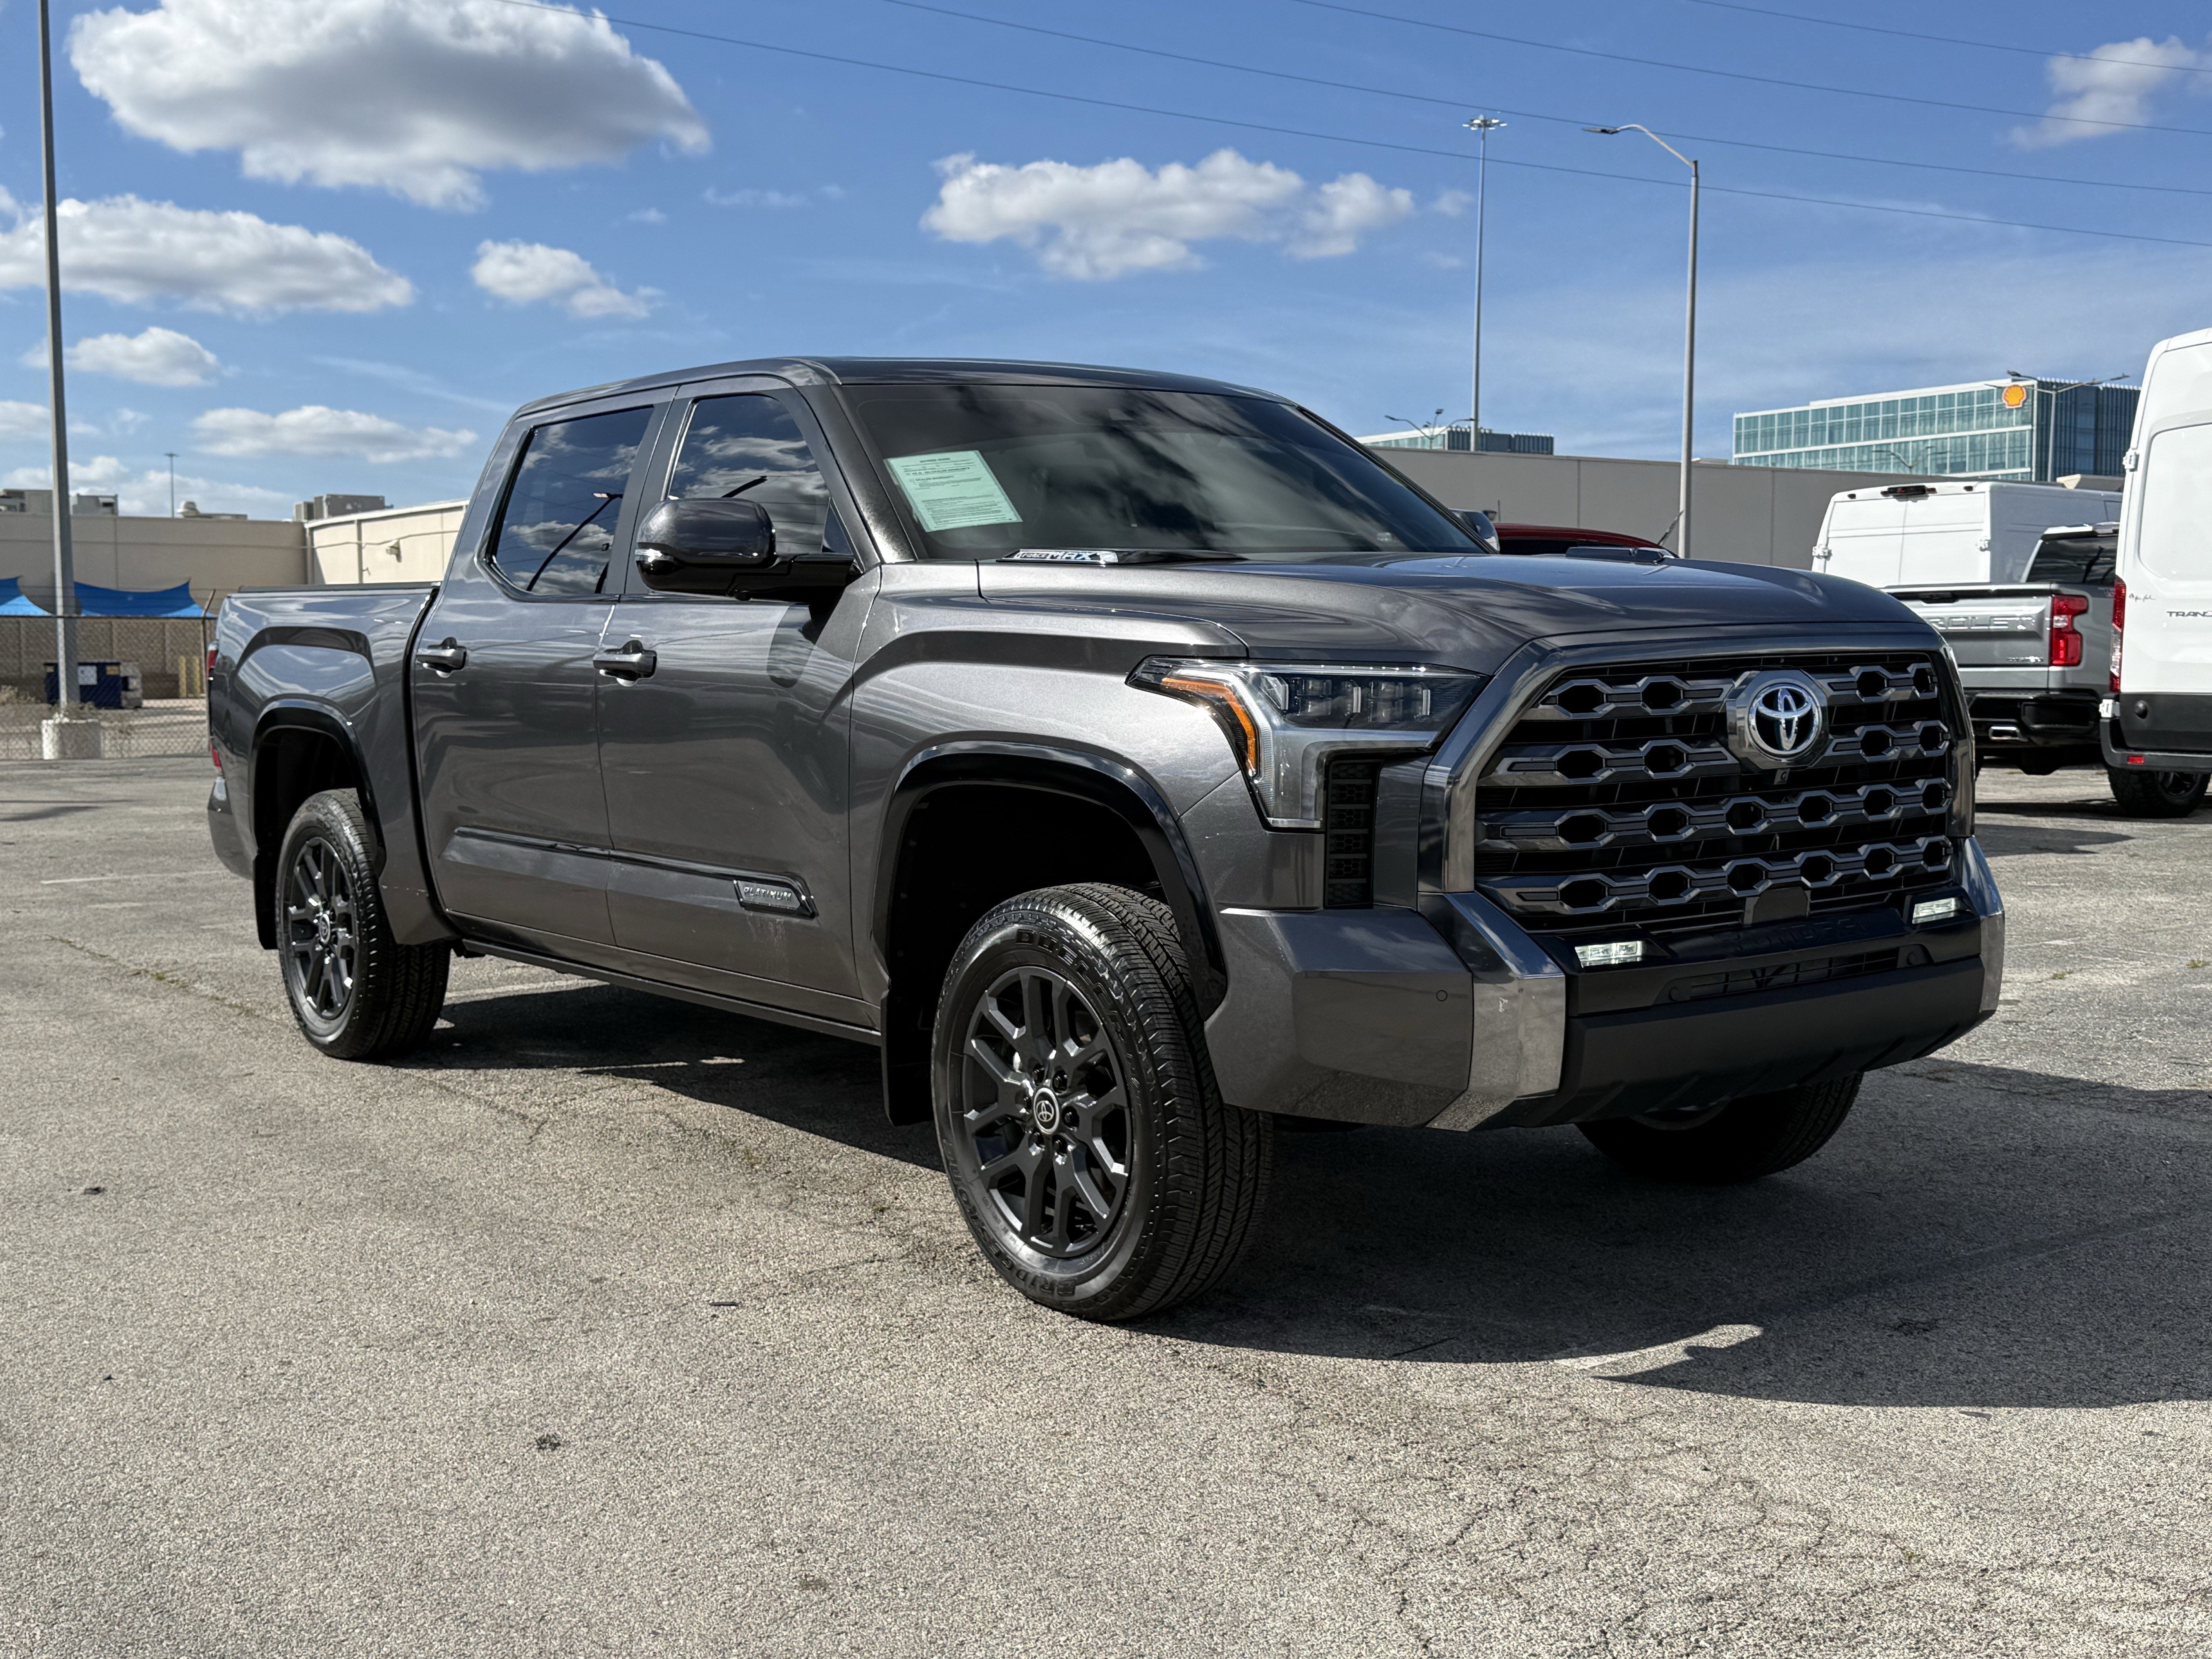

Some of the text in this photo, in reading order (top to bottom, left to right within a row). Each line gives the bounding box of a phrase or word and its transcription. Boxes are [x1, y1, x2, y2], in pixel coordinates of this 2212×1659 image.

[1046, 551, 1093, 560] MAX
[744, 886, 792, 901] PLATINUM
[1015, 929, 1125, 1041] DUELER
